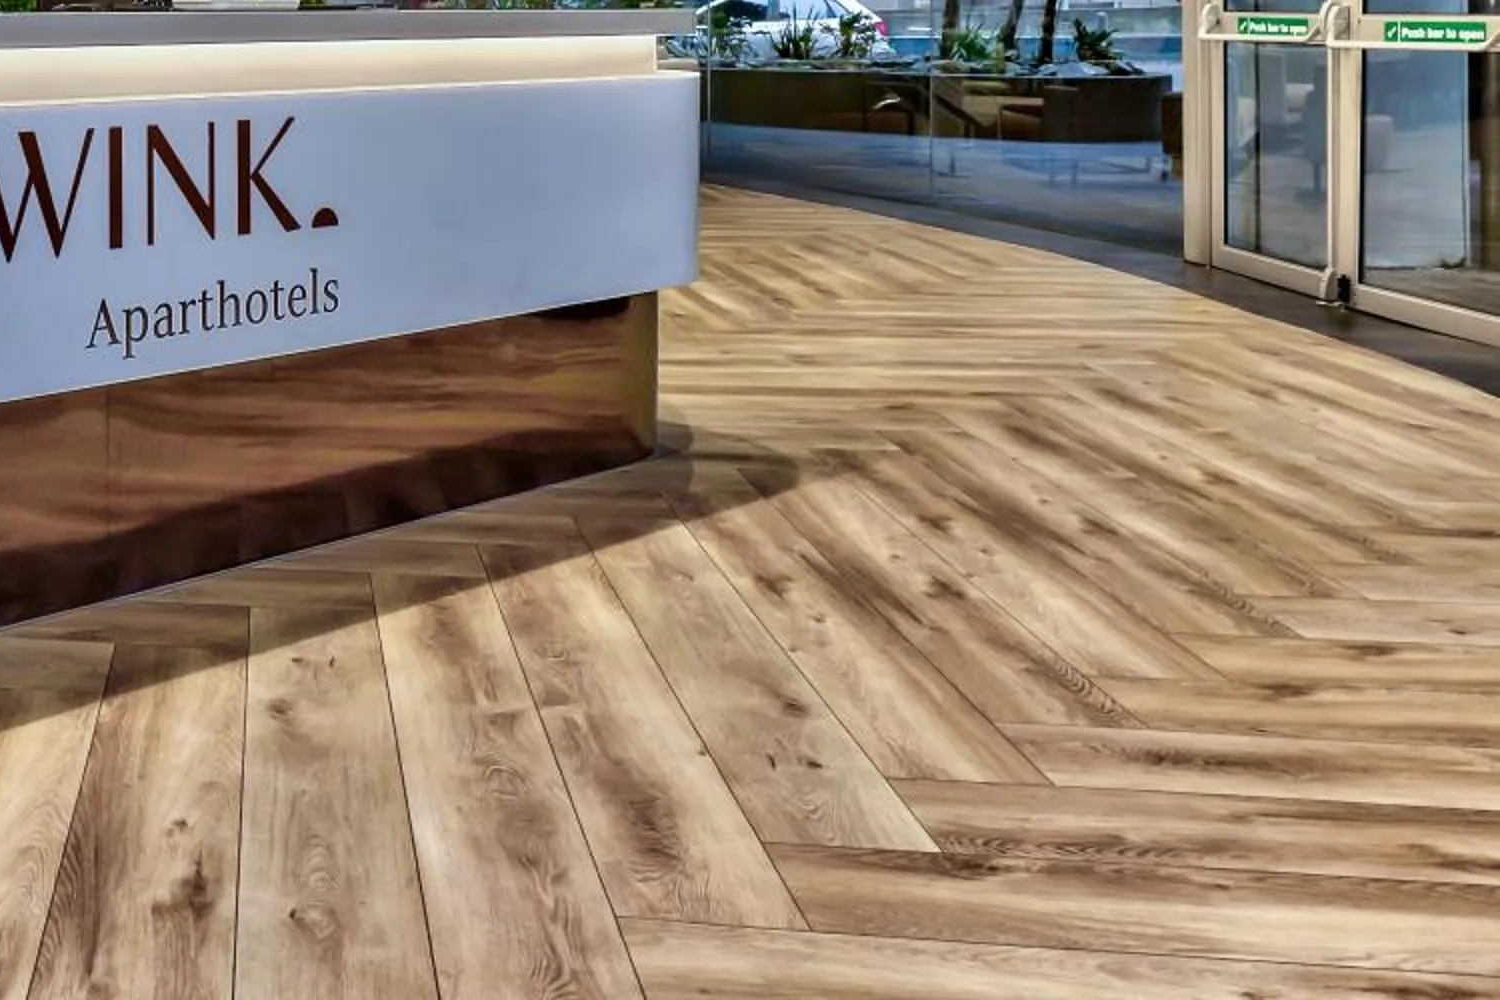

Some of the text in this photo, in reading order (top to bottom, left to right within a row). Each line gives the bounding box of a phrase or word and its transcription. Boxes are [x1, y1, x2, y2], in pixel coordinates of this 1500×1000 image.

[1401, 27, 1485, 43] Push bar to open
[85, 268, 340, 359] Aparthotels
